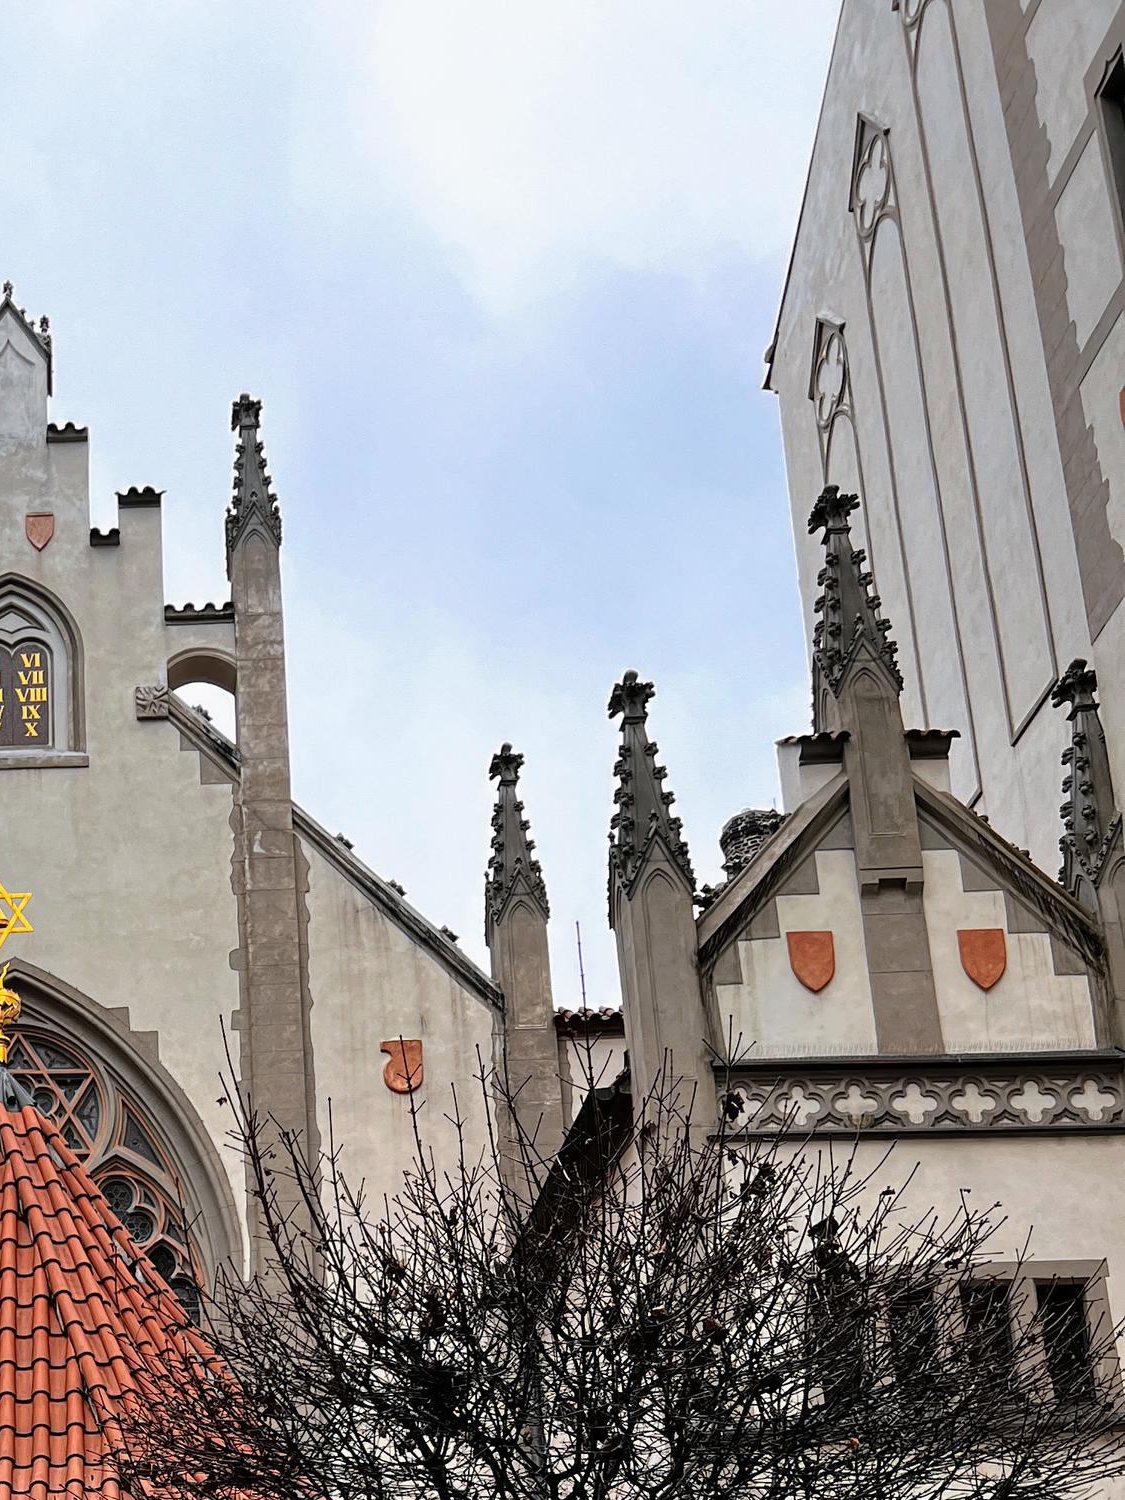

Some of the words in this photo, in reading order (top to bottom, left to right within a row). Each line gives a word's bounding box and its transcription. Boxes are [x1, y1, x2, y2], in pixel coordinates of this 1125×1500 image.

[20, 652, 41, 668] VI
[17, 670, 44, 685] VII
[14, 687, 48, 702] VIII
[21, 705, 41, 720] IX
[24, 722, 39, 737] X
